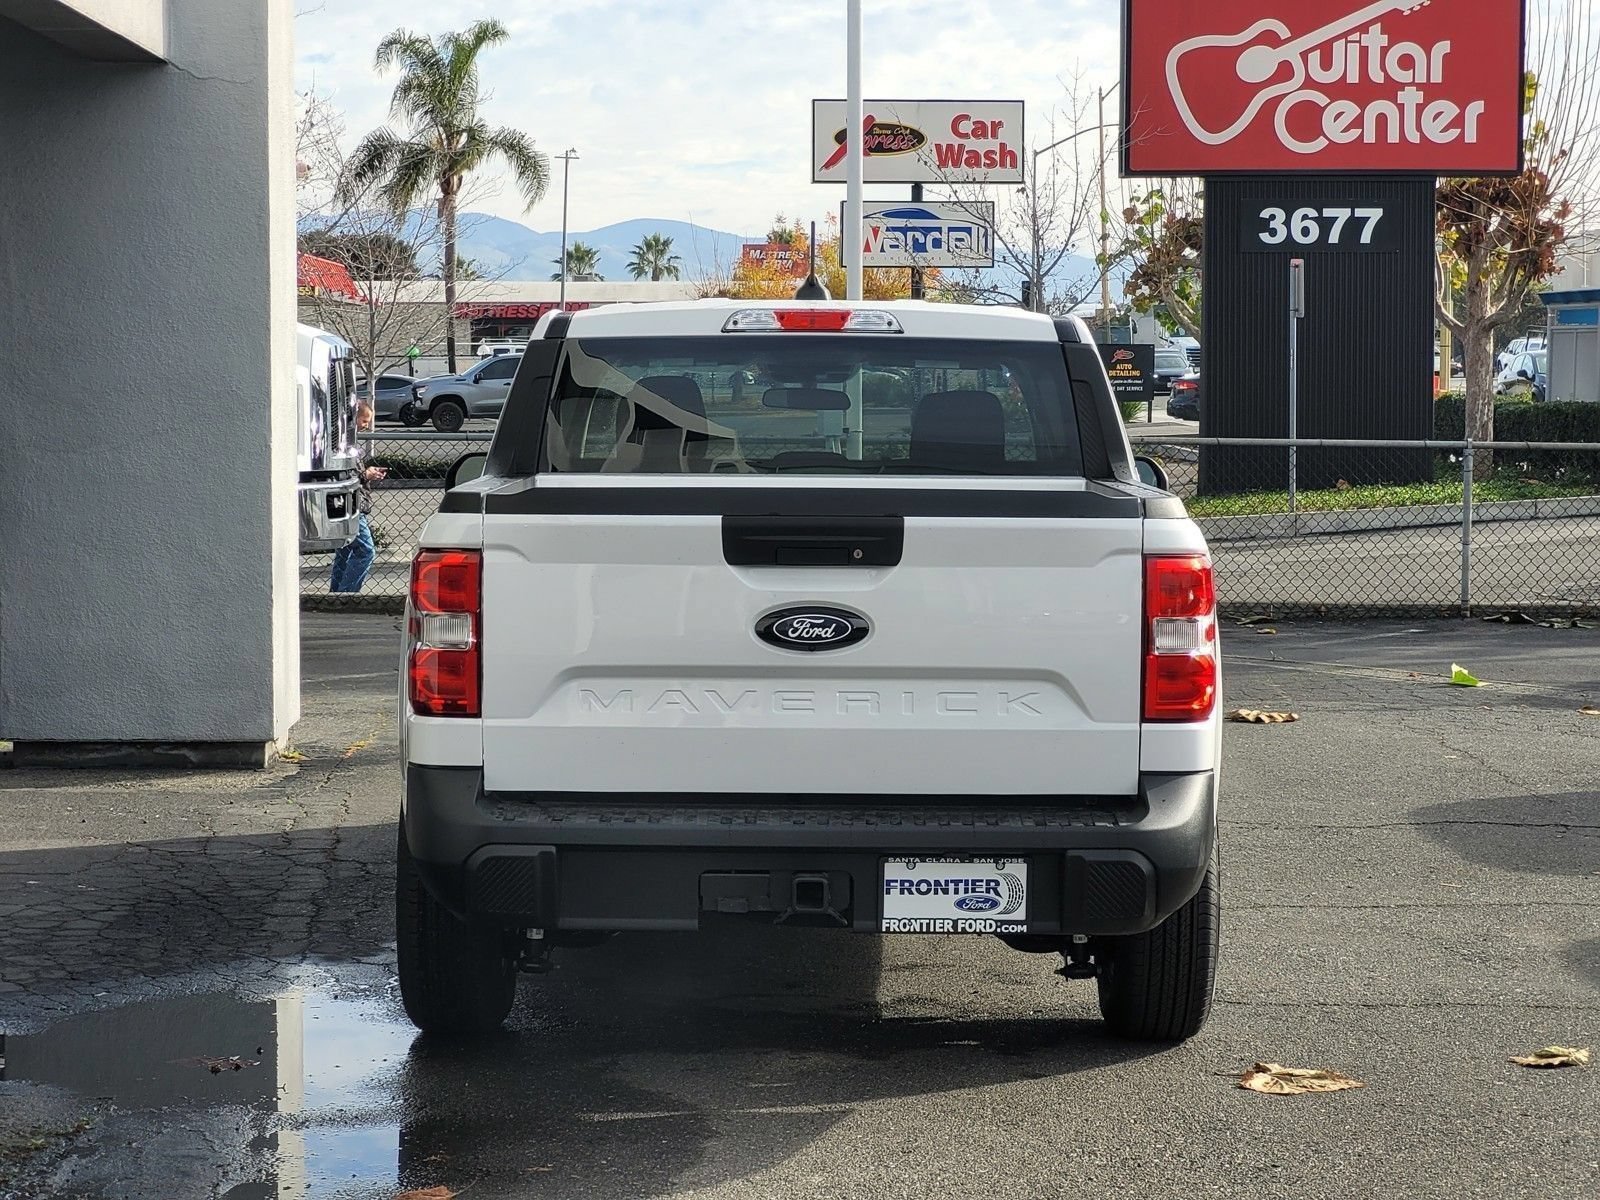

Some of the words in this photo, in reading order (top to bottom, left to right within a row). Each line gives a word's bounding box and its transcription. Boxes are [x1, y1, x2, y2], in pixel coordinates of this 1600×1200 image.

[950, 113, 1005, 140] Car
[1274, 86, 1485, 154] Center
[934, 142, 1018, 169] Wash
[1258, 207, 1384, 244] 3677
[788, 617, 837, 639] Ford
[578, 688, 1044, 716] MAVERICK
[885, 879, 1002, 898] FRONTIER
[962, 897, 991, 910] Ford
[881, 919, 954, 933] FRONTIER
